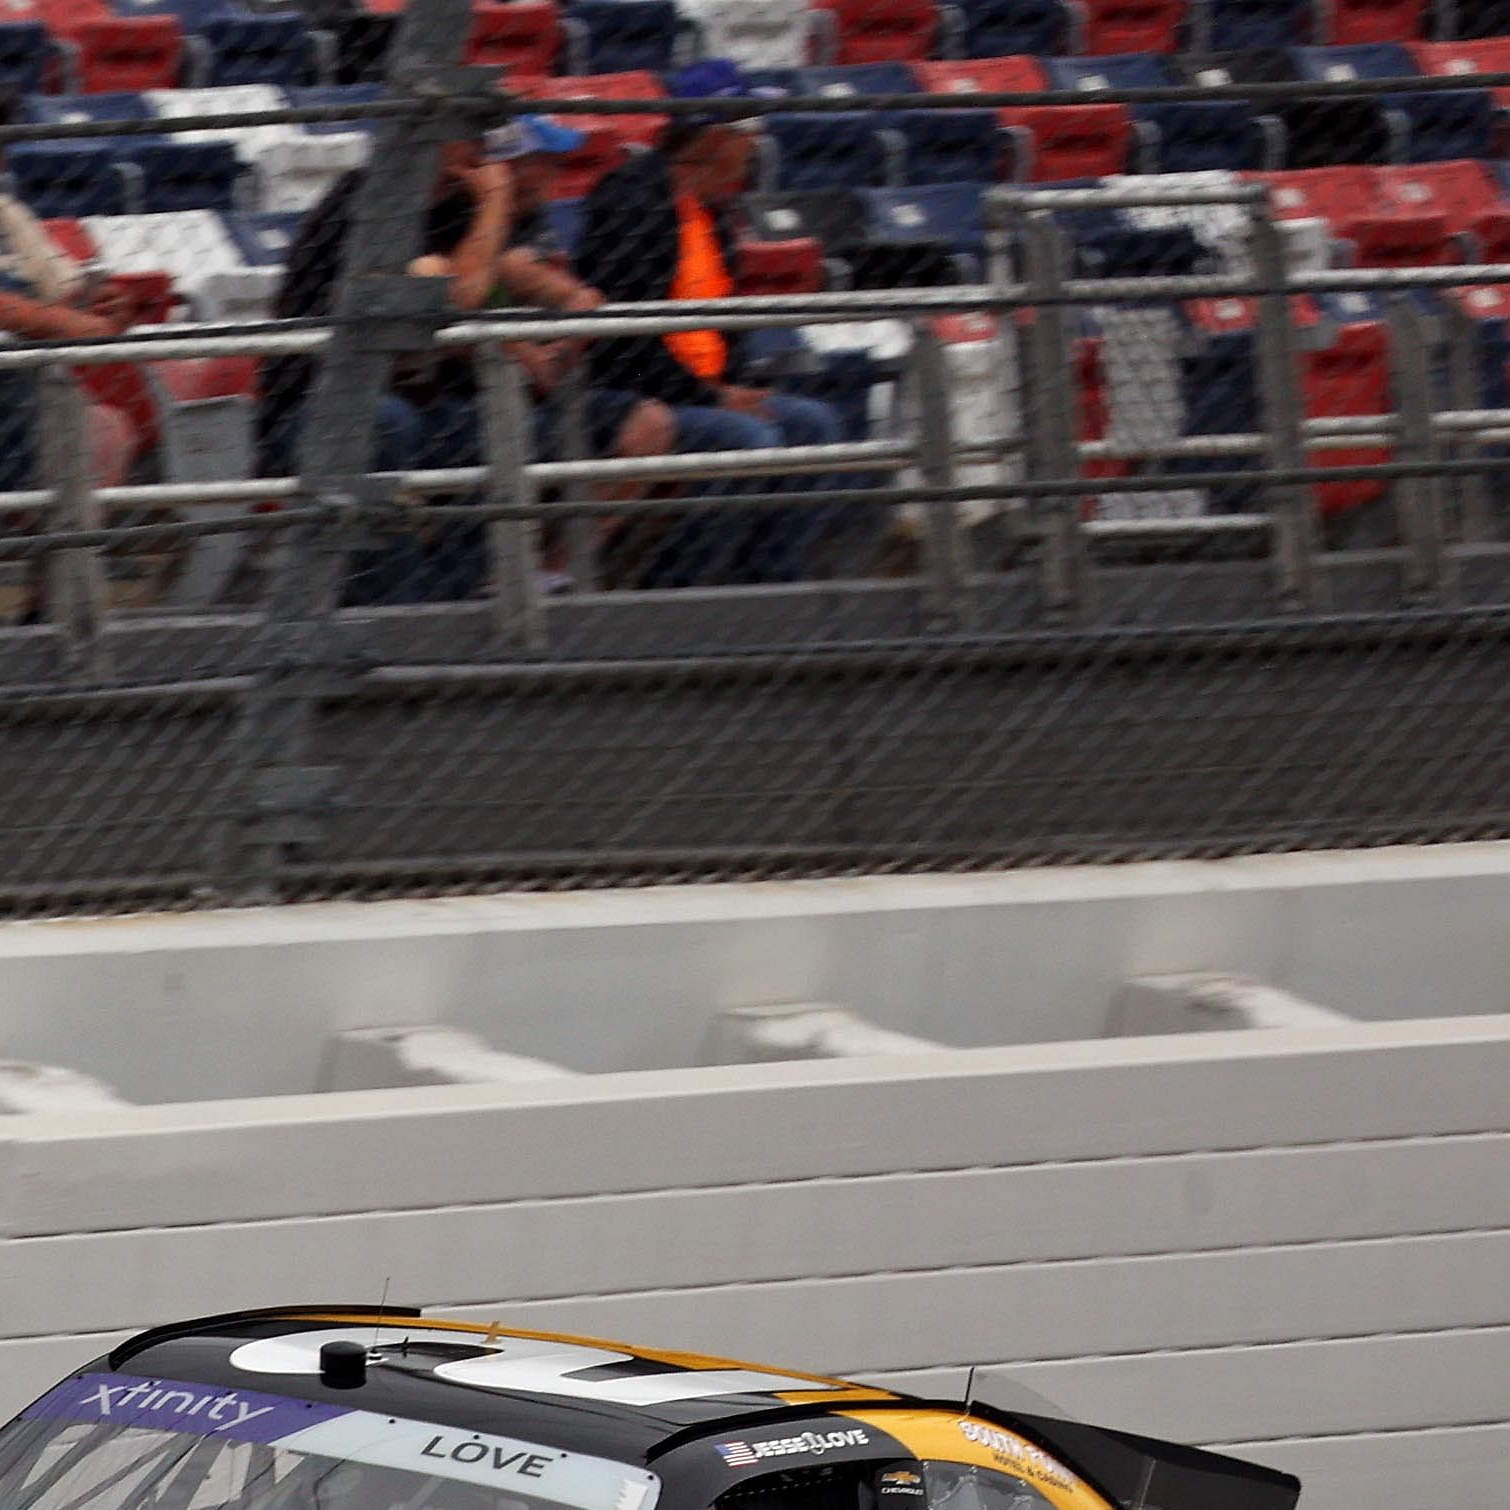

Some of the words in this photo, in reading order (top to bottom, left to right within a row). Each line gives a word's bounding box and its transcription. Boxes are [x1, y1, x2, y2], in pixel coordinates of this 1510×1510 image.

[82, 1380, 275, 1431] xfinity
[421, 1434, 555, 1478] LOVE
[817, 1429, 869, 1449] LOVE
